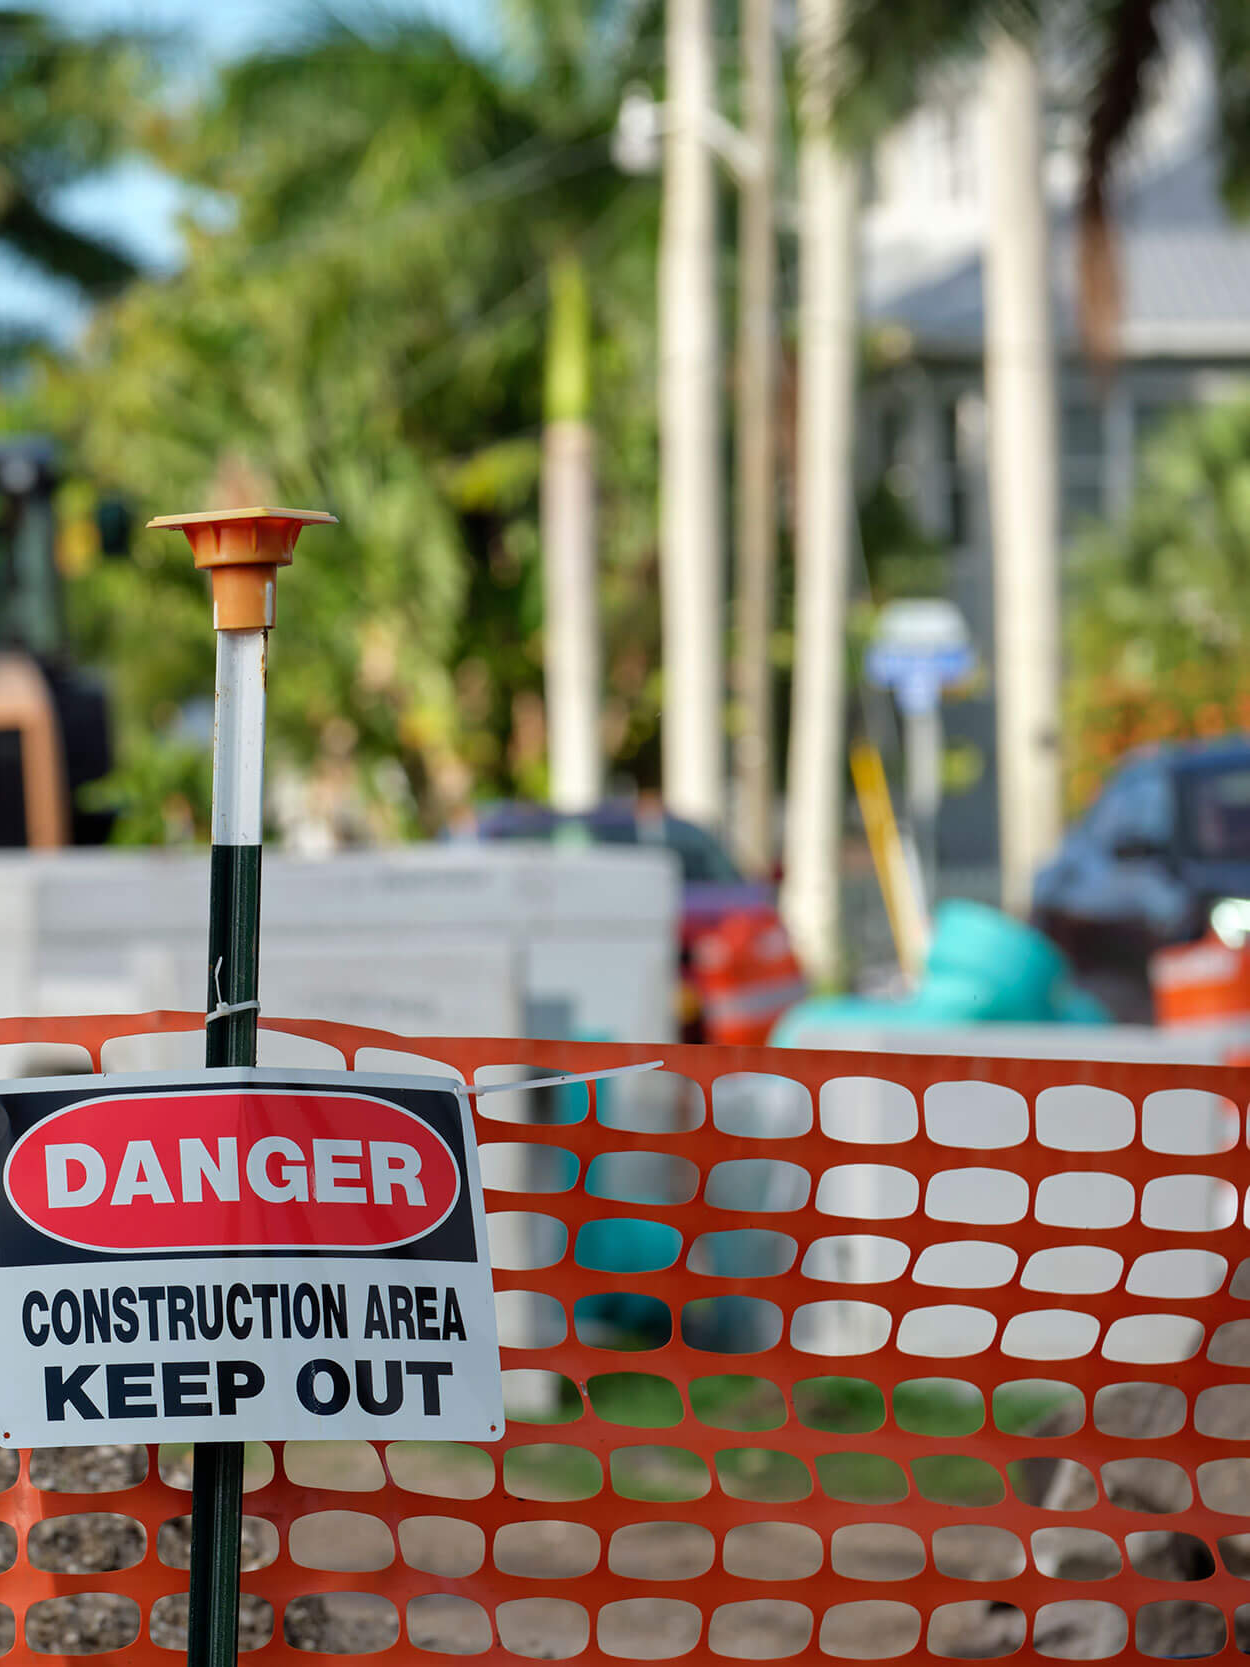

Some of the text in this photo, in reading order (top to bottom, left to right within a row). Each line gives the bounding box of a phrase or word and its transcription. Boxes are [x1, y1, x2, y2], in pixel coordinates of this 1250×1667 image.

[45, 1136, 428, 1209] DANGER
[22, 1283, 467, 1347] CONSTRUCTION AREA
[44, 1358, 453, 1421] KEEP OUT
